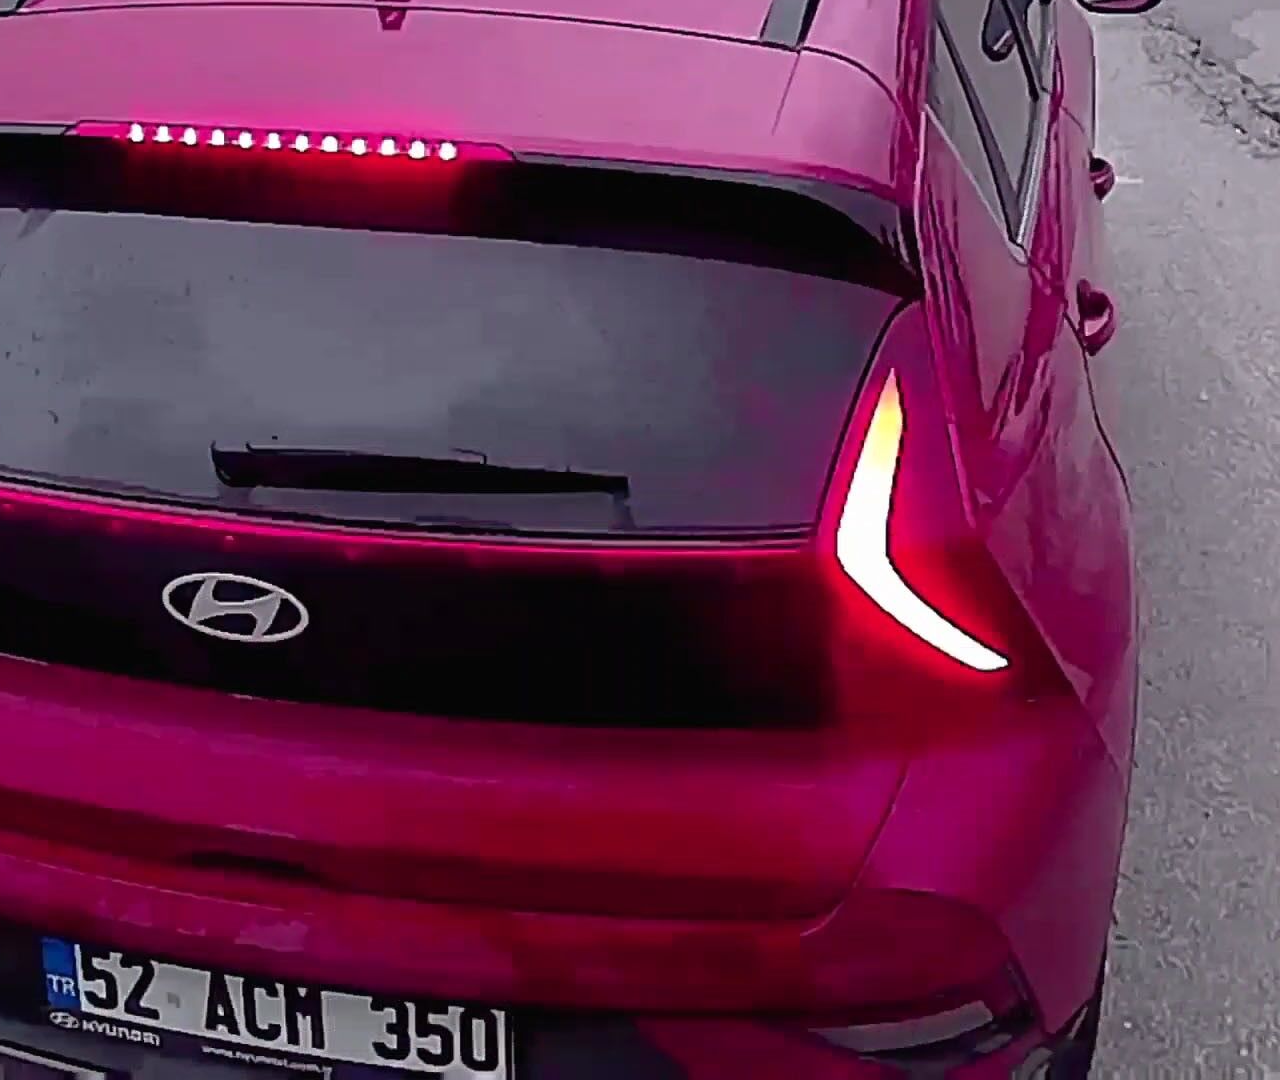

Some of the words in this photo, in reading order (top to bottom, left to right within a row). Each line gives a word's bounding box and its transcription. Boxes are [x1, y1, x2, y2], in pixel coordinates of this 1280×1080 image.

[46, 973, 76, 997] TR
[80, 947, 160, 1021] 52
[370, 995, 499, 1072] 350
